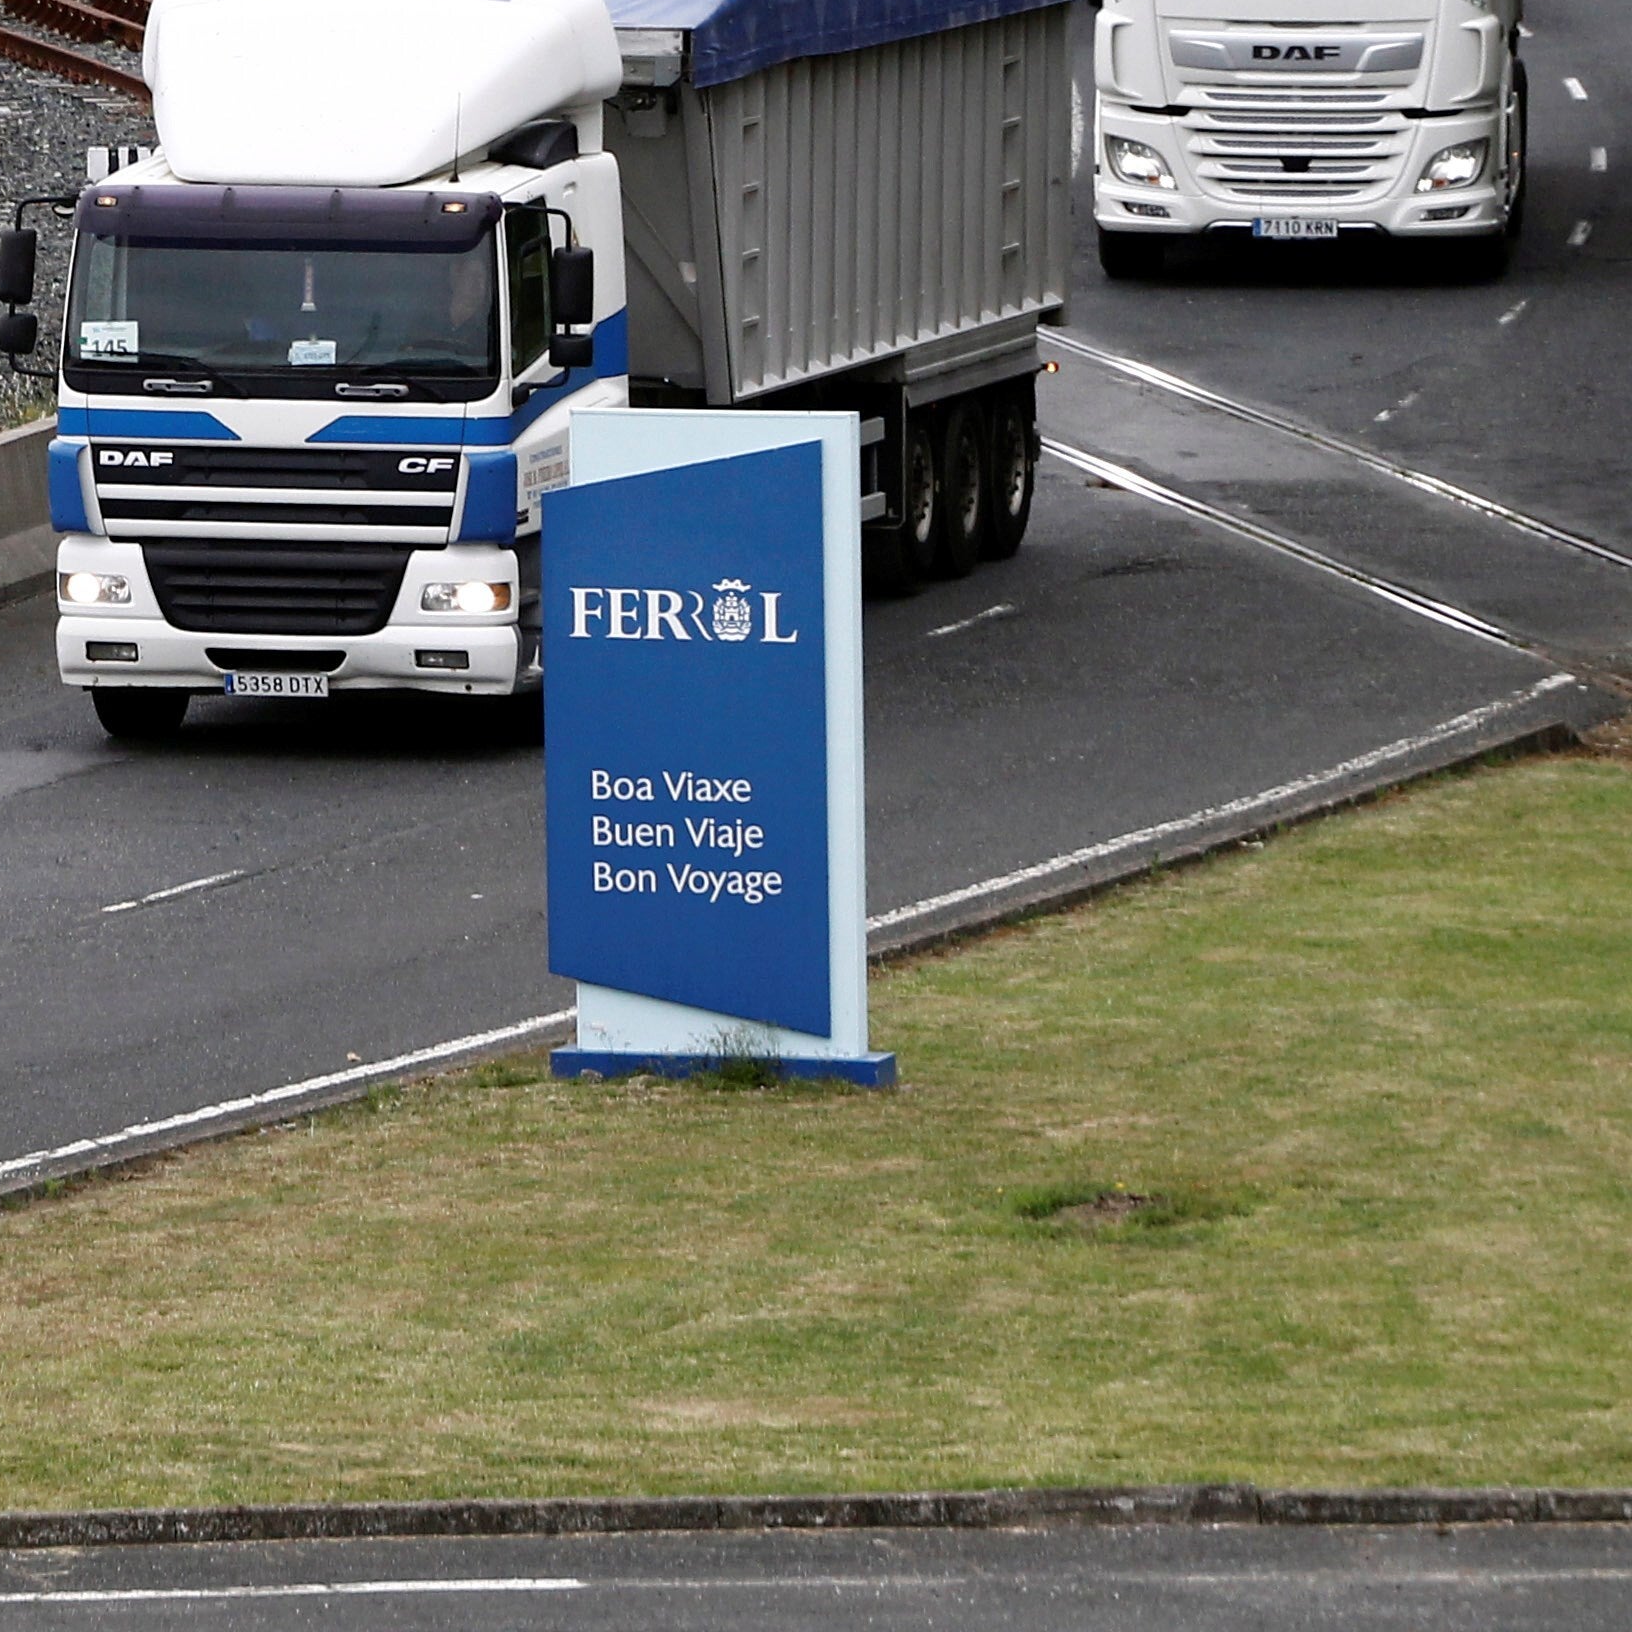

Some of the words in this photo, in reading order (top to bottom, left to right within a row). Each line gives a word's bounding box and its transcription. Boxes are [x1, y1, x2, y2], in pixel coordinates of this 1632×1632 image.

[1251, 45, 1341, 60] DAF
[1305, 220, 1334, 235] KRN
[92, 339, 128, 357] 145
[99, 449, 174, 468] DAF
[397, 457, 455, 474] CF
[237, 675, 283, 693] 5358
[289, 676, 324, 694] DTX
[591, 770, 655, 801] Boa
[662, 770, 752, 802] Viaxe
[592, 815, 675, 848] Buen
[684, 817, 764, 858] Viaje
[593, 862, 657, 893] Bon
[666, 863, 783, 905] Voyage
